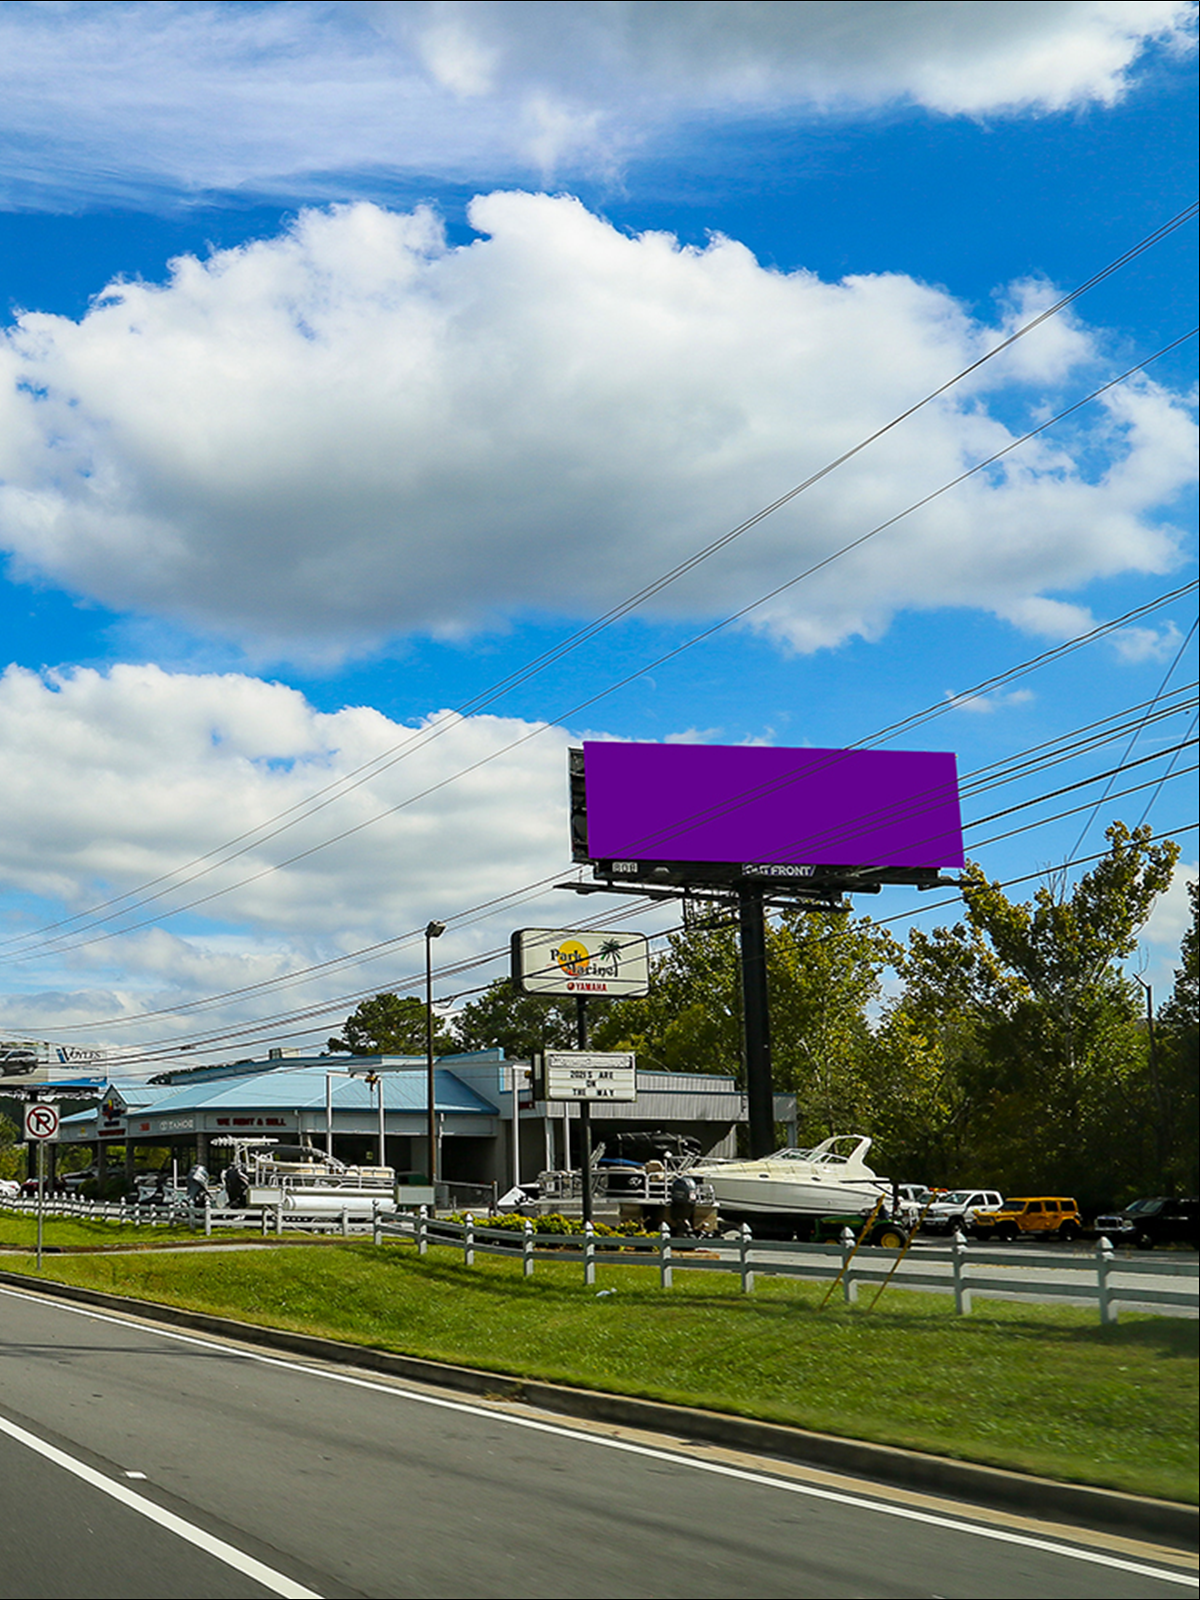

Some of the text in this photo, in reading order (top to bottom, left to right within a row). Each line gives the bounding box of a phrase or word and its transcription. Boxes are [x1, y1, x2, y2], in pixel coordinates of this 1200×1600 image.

[550, 948, 581, 961] Park
[576, 982, 607, 991] YAMAHA
[599, 1071, 614, 1080] ARE
[573, 1088, 614, 1096] THE WAY
